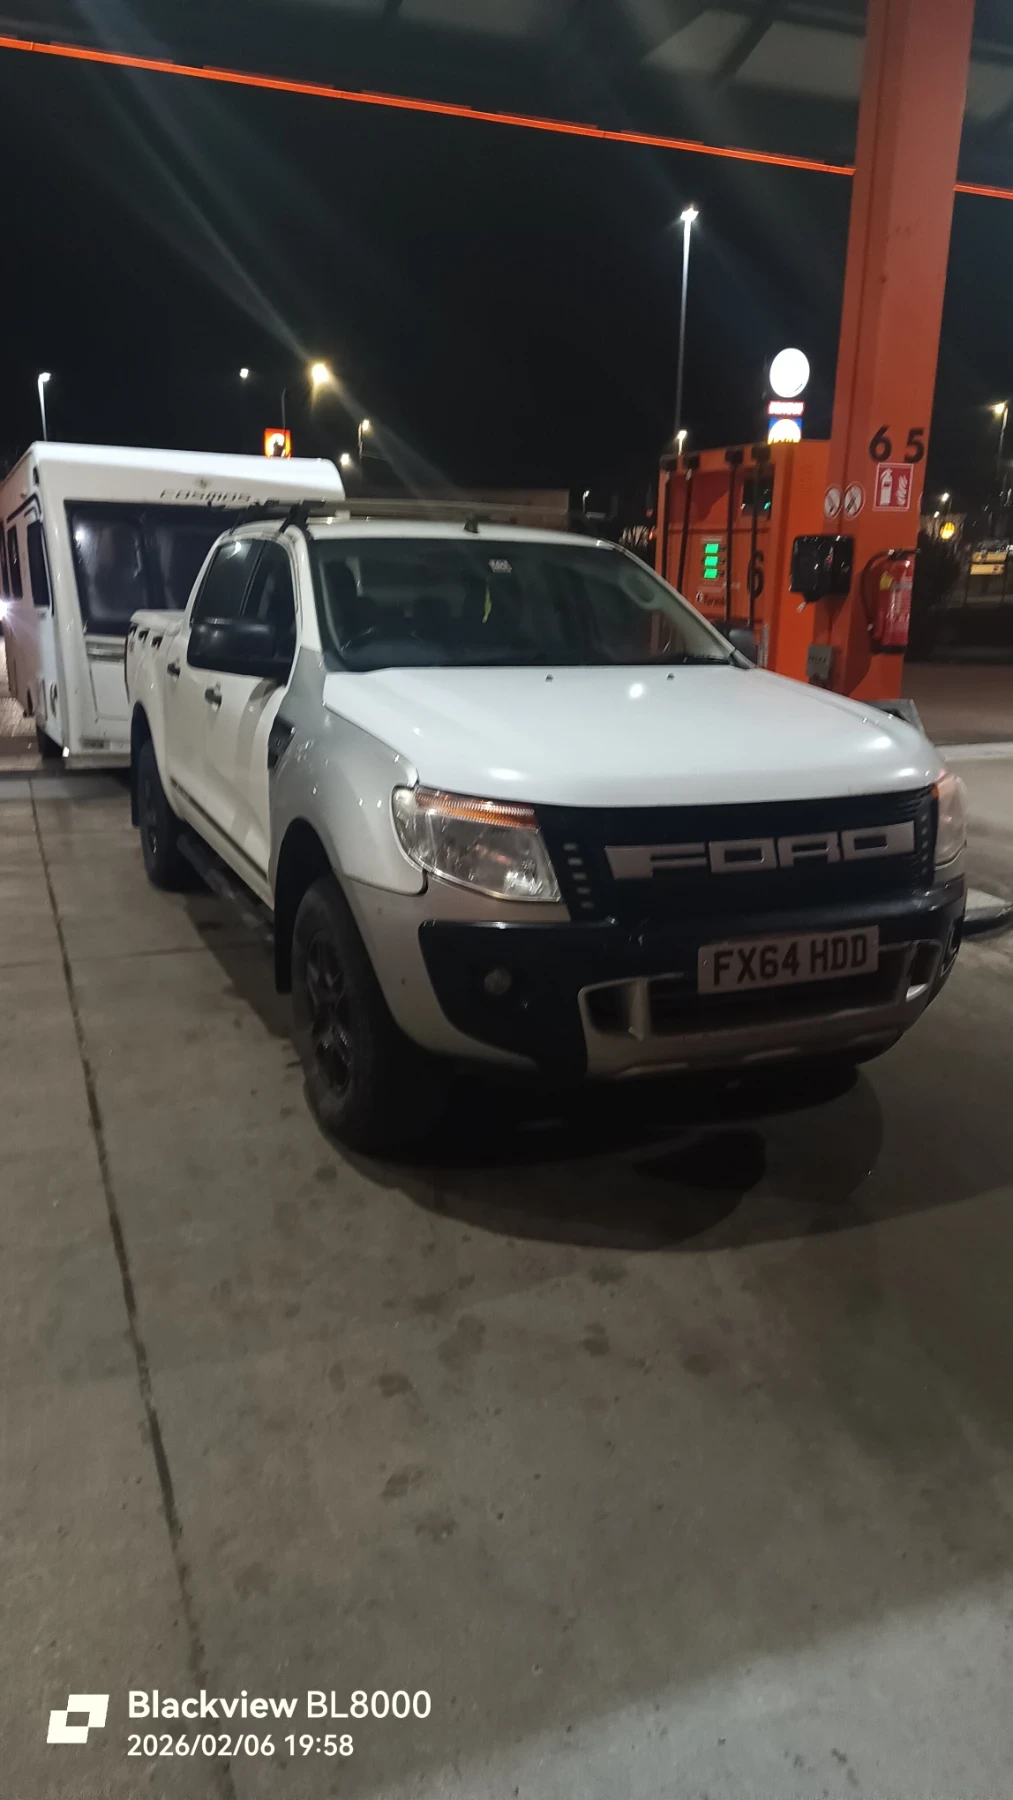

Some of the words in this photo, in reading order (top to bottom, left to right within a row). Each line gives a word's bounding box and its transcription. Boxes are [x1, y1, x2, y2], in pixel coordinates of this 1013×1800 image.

[869, 424, 892, 463] 6
[904, 427, 925, 464] 5
[747, 550, 765, 599] 6
[605, 821, 915, 880] FORD
[712, 944, 799, 986] FX64
[810, 935, 867, 973] HDD
